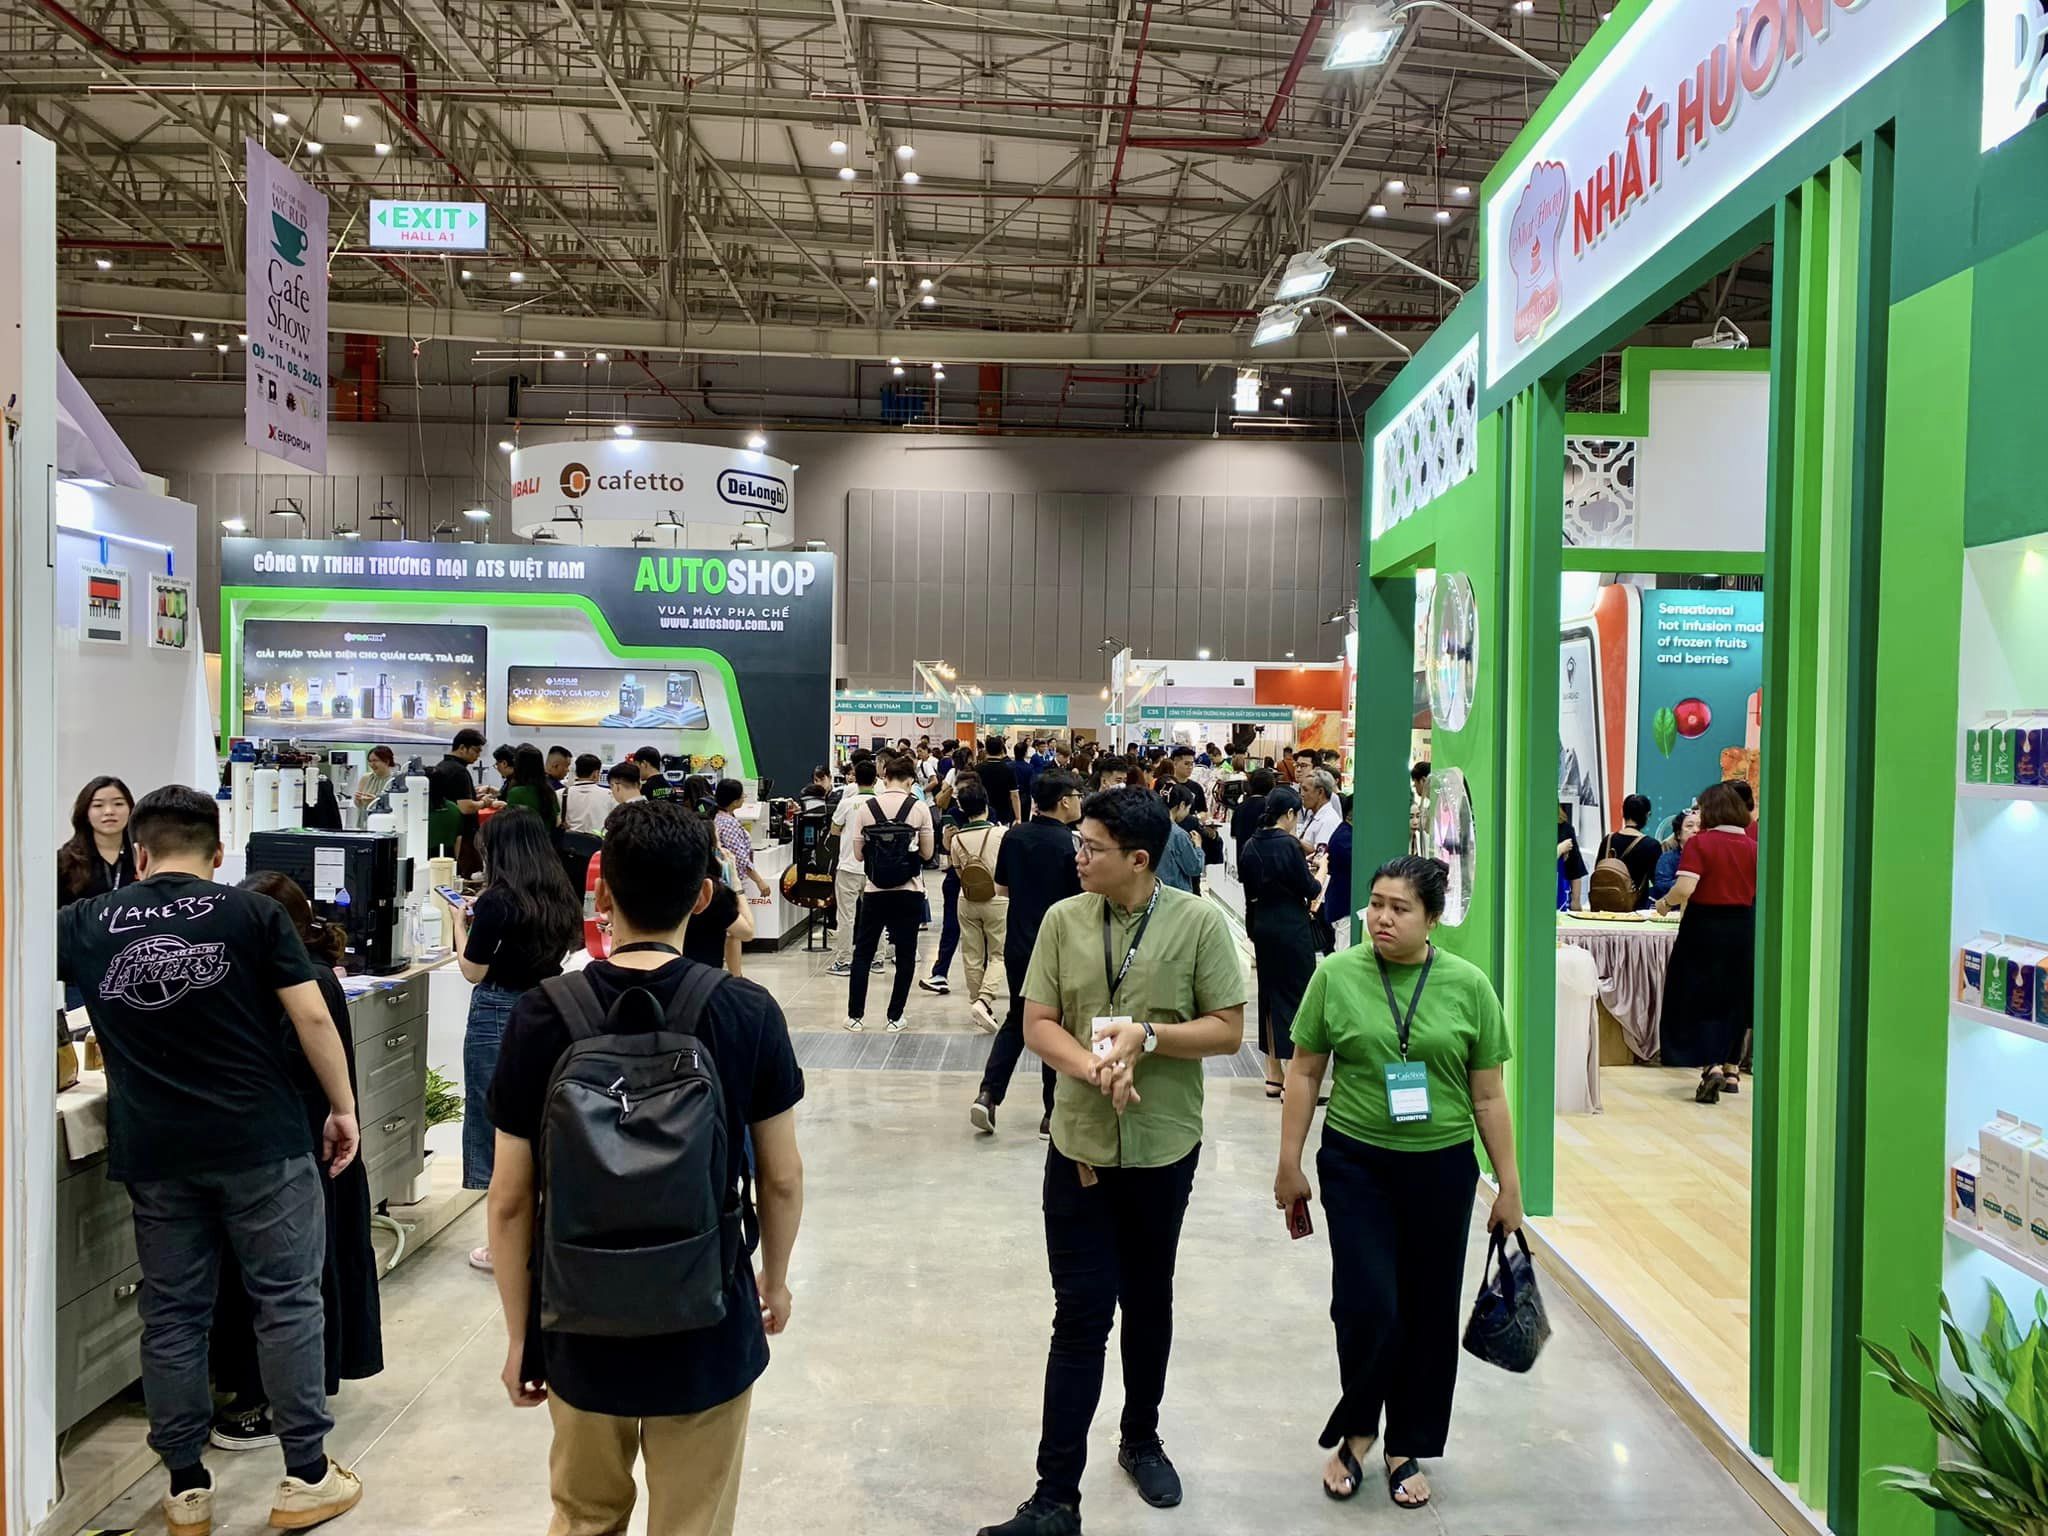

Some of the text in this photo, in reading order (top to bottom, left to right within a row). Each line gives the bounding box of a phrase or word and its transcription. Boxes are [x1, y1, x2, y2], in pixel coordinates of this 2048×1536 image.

[1572, 85, 1669, 260] NHẤT
[1677, 0, 1871, 164] HƯƠN
[272, 193, 308, 230] WORLD
[392, 207, 462, 229] EXIT
[401, 231, 455, 242] HALL A1
[268, 259, 310, 313] Cafe
[267, 295, 311, 345] Show
[268, 333, 310, 363] VIETNAM
[597, 470, 685, 492] cafetto
[253, 550, 585, 582] CÔNG TY TNHH THƯƠNG MẠI ATS VIỆT NAM
[633, 556, 816, 597] AUTOSHOP
[658, 603, 790, 619] VUA MÁY PHA CHẾ
[1658, 602, 1734, 616] Sensational
[660, 617, 784, 633] www.autoshop.com.vn
[1658, 619, 1680, 631] hot
[1682, 619, 1732, 632] infusion
[1657, 635, 1747, 649] of frozen fruits
[278, 648, 303, 658] PHÁP
[306, 648, 332, 659] TOÀN
[358, 650, 379, 660] CHO
[380, 649, 406, 661] QUÁN
[1657, 652, 1729, 664] and berries
[101, 954, 224, 993] LAKERS
